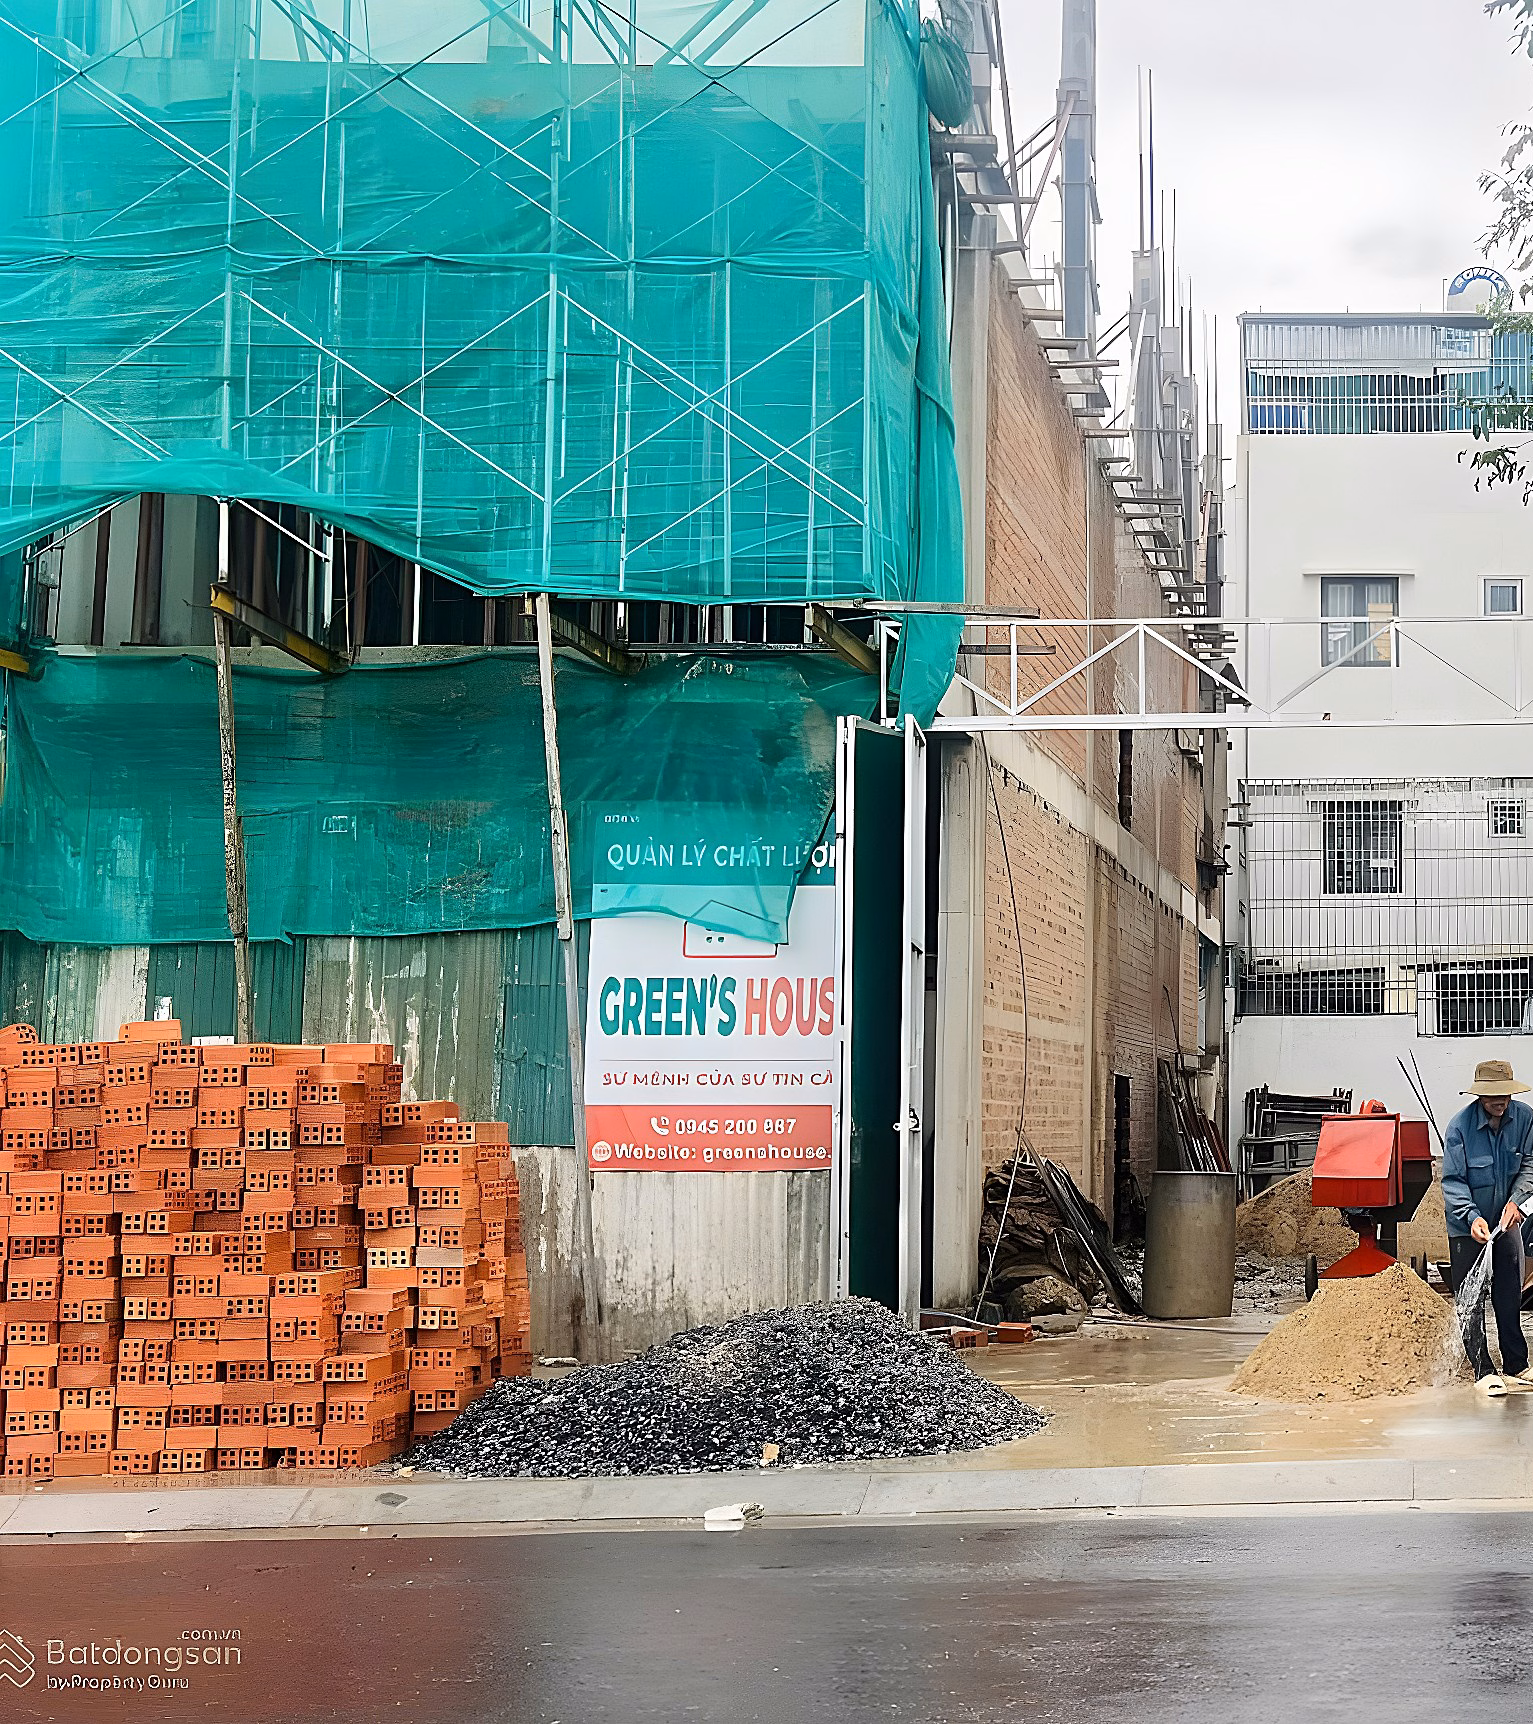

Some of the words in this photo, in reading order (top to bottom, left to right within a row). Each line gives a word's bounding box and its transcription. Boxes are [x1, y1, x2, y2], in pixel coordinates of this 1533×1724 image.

[681, 838, 707, 867] LÝ
[713, 836, 776, 867] CHẤT
[599, 973, 737, 1037] GREEN'S
[743, 976, 835, 1037] HOUS
[772, 1073, 803, 1086] TIN
[675, 1118, 719, 1135] 0945
[723, 1118, 758, 1135] 200
[613, 1142, 696, 1160] Website:
